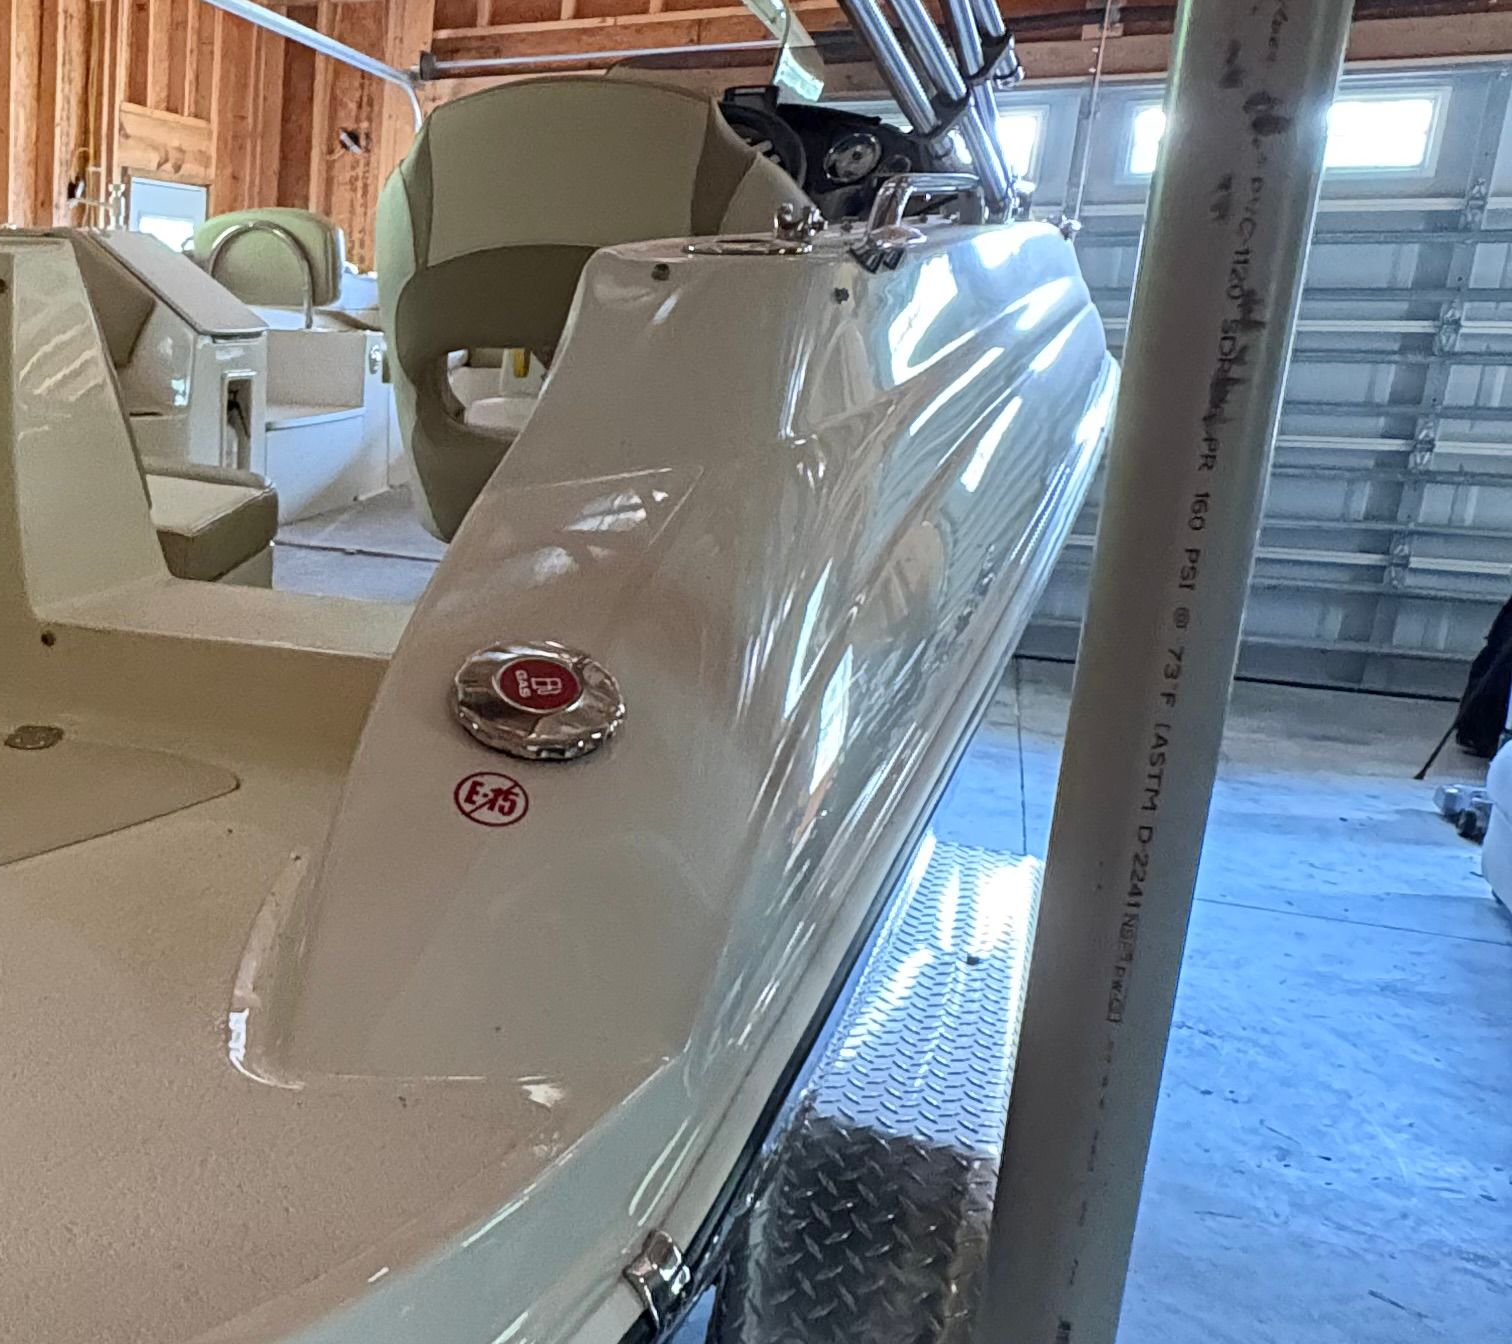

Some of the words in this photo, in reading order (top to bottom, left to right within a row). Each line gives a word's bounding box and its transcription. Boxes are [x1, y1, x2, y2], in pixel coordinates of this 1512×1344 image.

[1198, 437, 1219, 472] PR
[1189, 492, 1211, 532] 160
[1179, 548, 1201, 592] PSI
[514, 669, 532, 699] GAS
[463, 779, 520, 817] E-15
